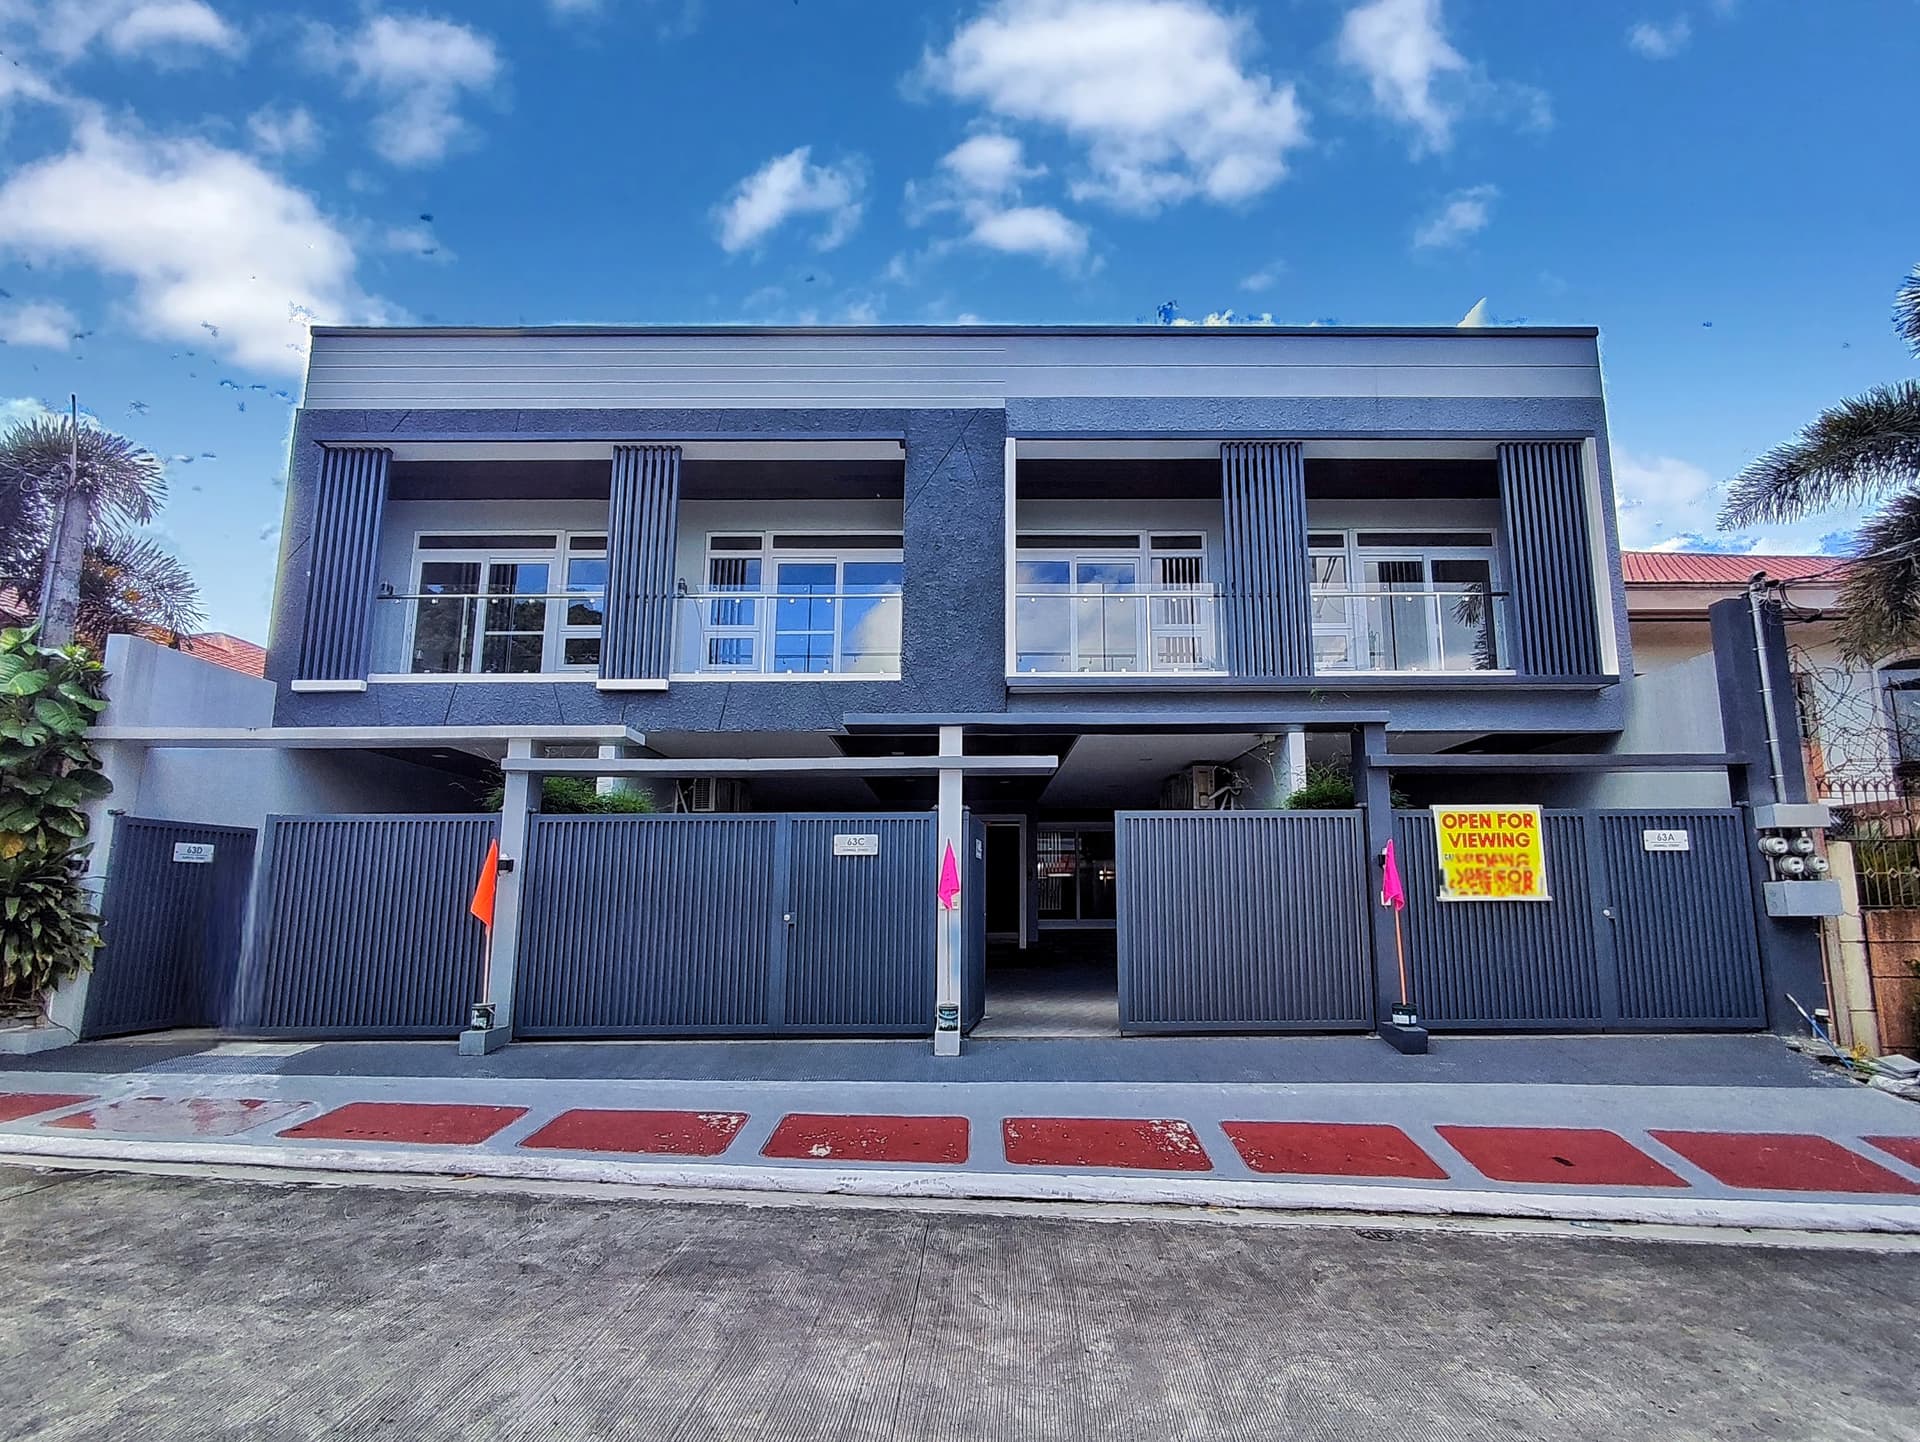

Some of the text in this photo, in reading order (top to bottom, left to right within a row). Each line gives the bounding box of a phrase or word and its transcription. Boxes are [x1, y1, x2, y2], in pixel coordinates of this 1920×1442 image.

[1442, 813, 1534, 829] OPEN FOR
[847, 837, 865, 846] 63C
[1447, 832, 1530, 848] VIEWING
[1656, 833, 1675, 842] 63A
[186, 846, 203, 854] 63D
